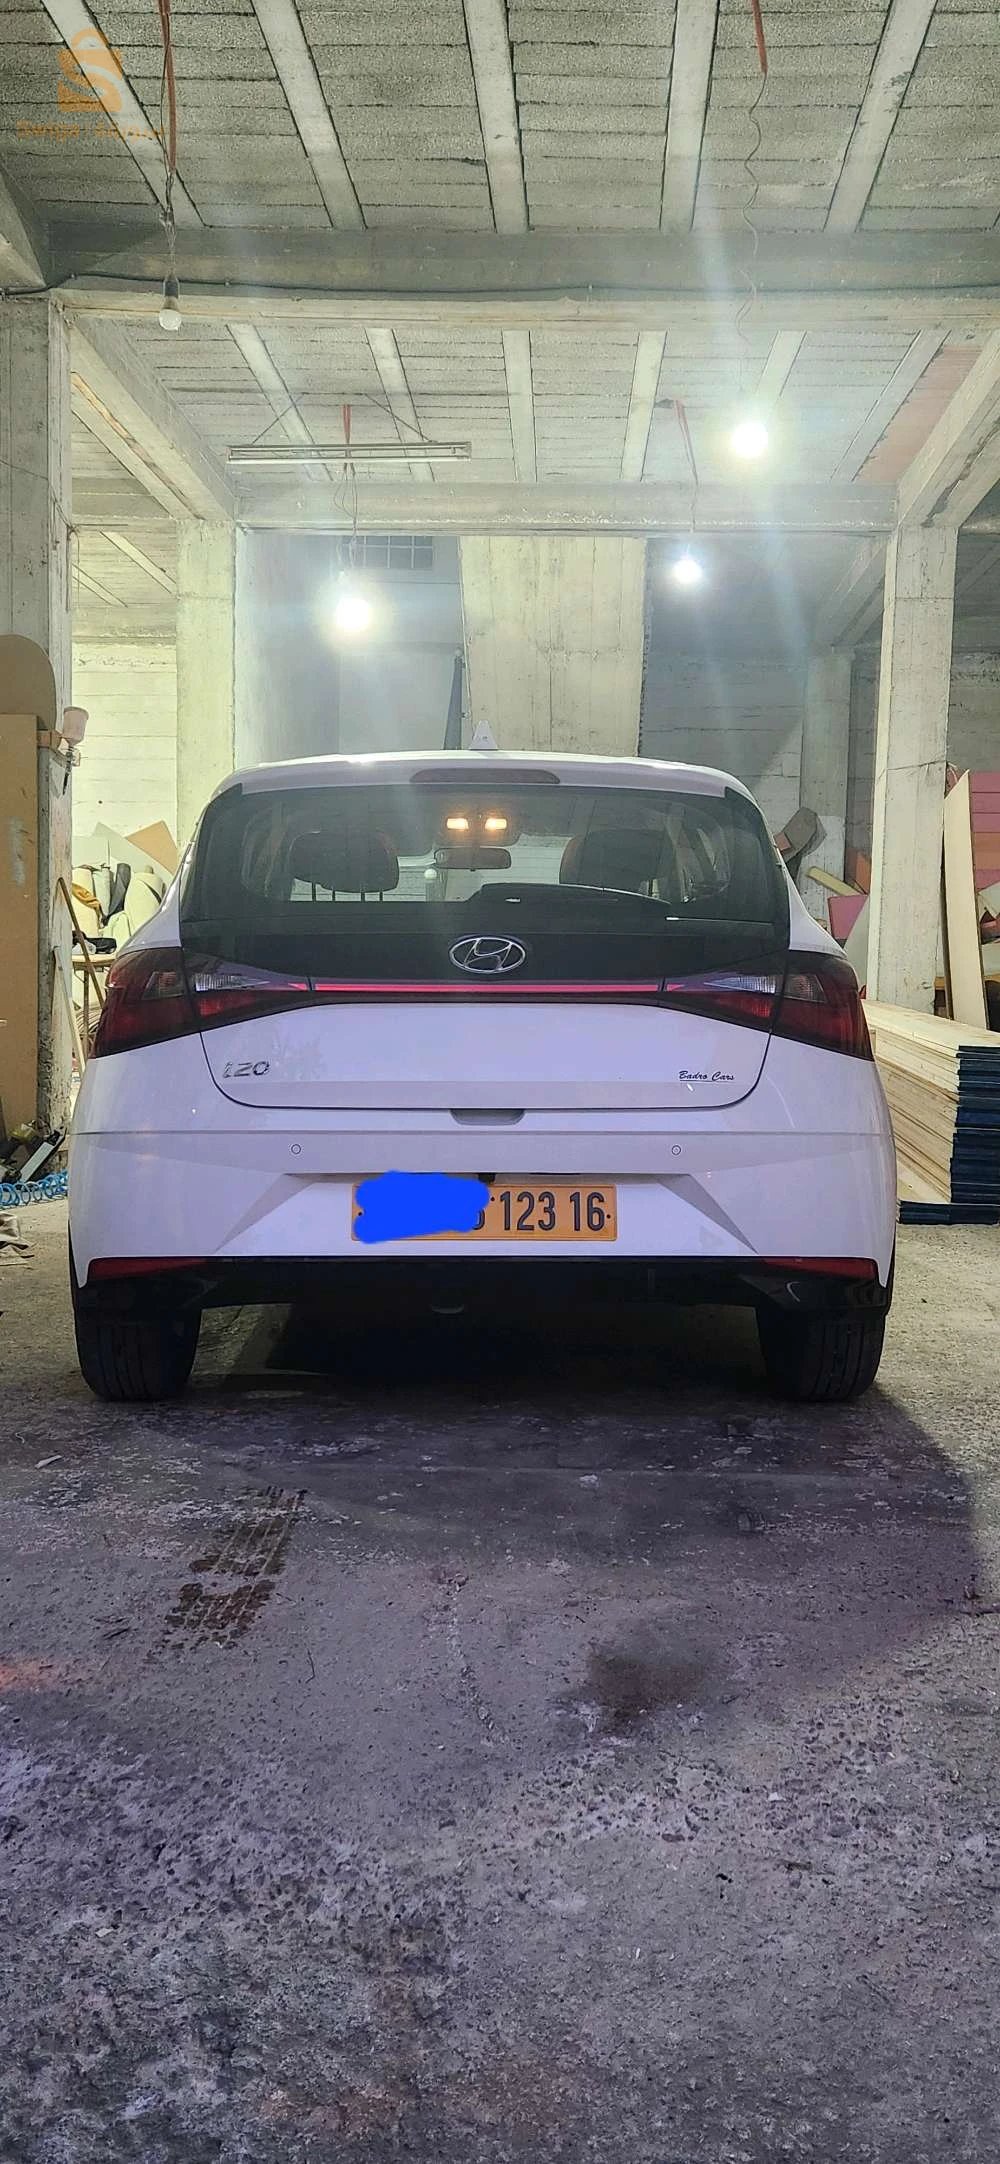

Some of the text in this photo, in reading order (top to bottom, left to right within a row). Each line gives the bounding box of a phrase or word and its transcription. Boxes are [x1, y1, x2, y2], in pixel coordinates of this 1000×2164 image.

[711, 1071, 734, 1081] Cars
[500, 1191, 556, 1231] 123
[569, 1191, 605, 1231] 16
